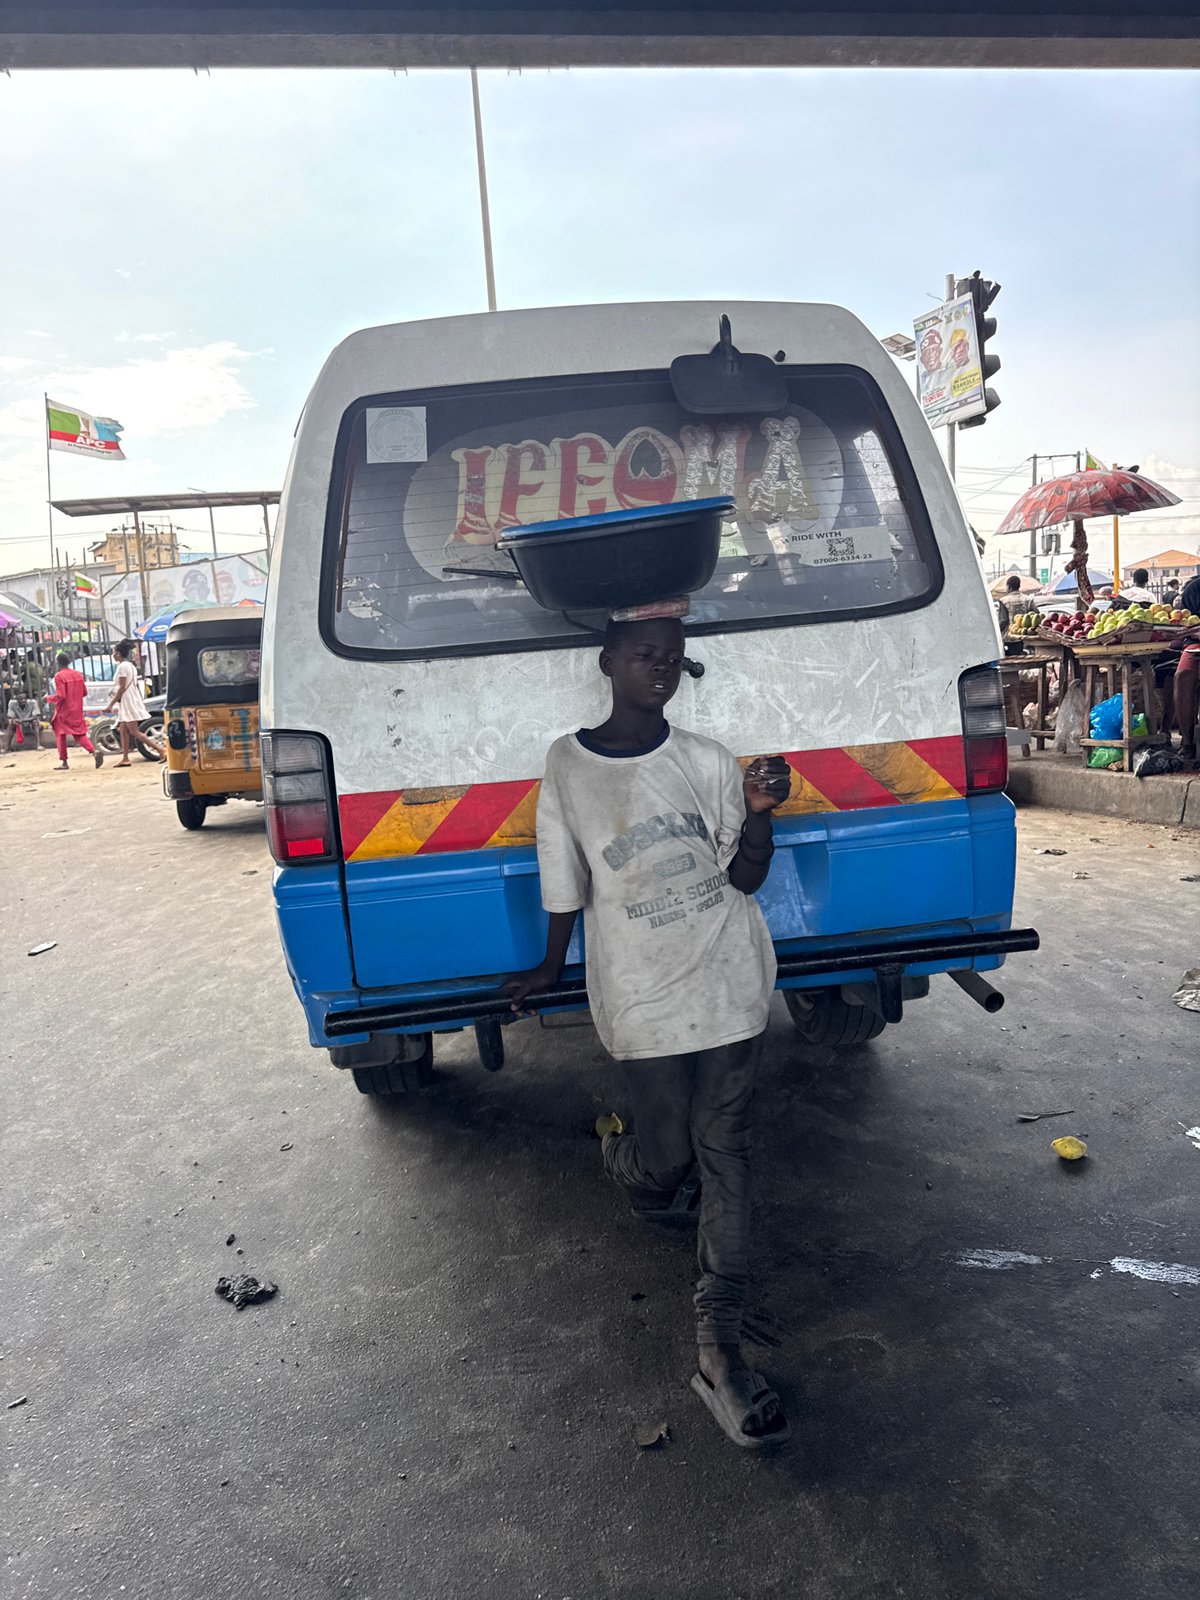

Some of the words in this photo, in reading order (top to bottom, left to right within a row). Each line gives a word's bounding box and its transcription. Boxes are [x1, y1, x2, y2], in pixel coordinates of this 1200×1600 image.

[75, 436, 106, 448] APC
[791, 533, 815, 542] RIDE
[816, 531, 842, 539] WITH
